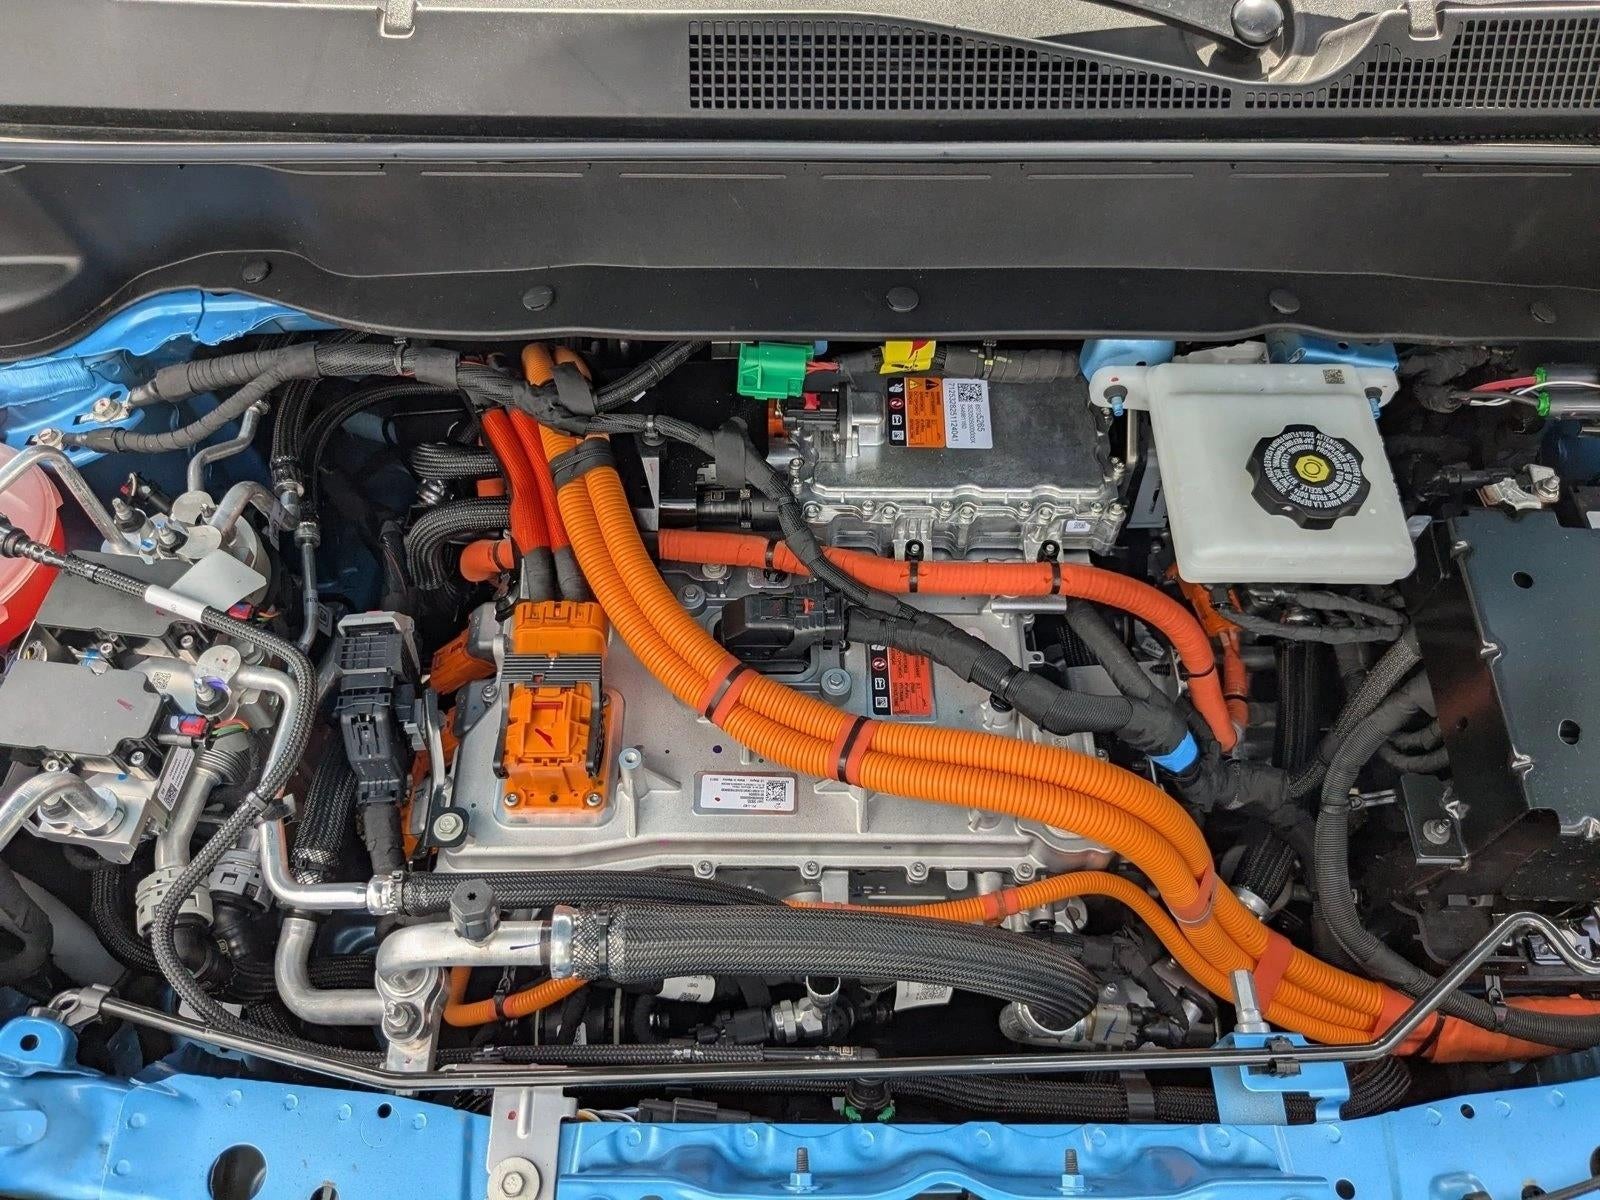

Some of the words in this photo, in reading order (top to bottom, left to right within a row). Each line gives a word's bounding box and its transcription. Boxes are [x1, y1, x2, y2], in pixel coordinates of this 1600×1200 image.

[1269, 435, 1285, 448] FROM
[1280, 431, 1299, 440] FLUID
[1280, 437, 1303, 449] BEFORE
[1263, 448, 1273, 466] SEALED
[1280, 452, 1291, 468] CLEAN
[1315, 446, 1343, 469] PROVENANT
[1272, 468, 1282, 478] USE
[1341, 462, 1352, 472] QUE
[1280, 468, 1297, 486] FILLER
[1277, 478, 1292, 491] ONLY
[1322, 481, 1341, 494] BIDON
[1339, 483, 1359, 503] BOUCHON
[1322, 499, 1343, 508] AVANT
